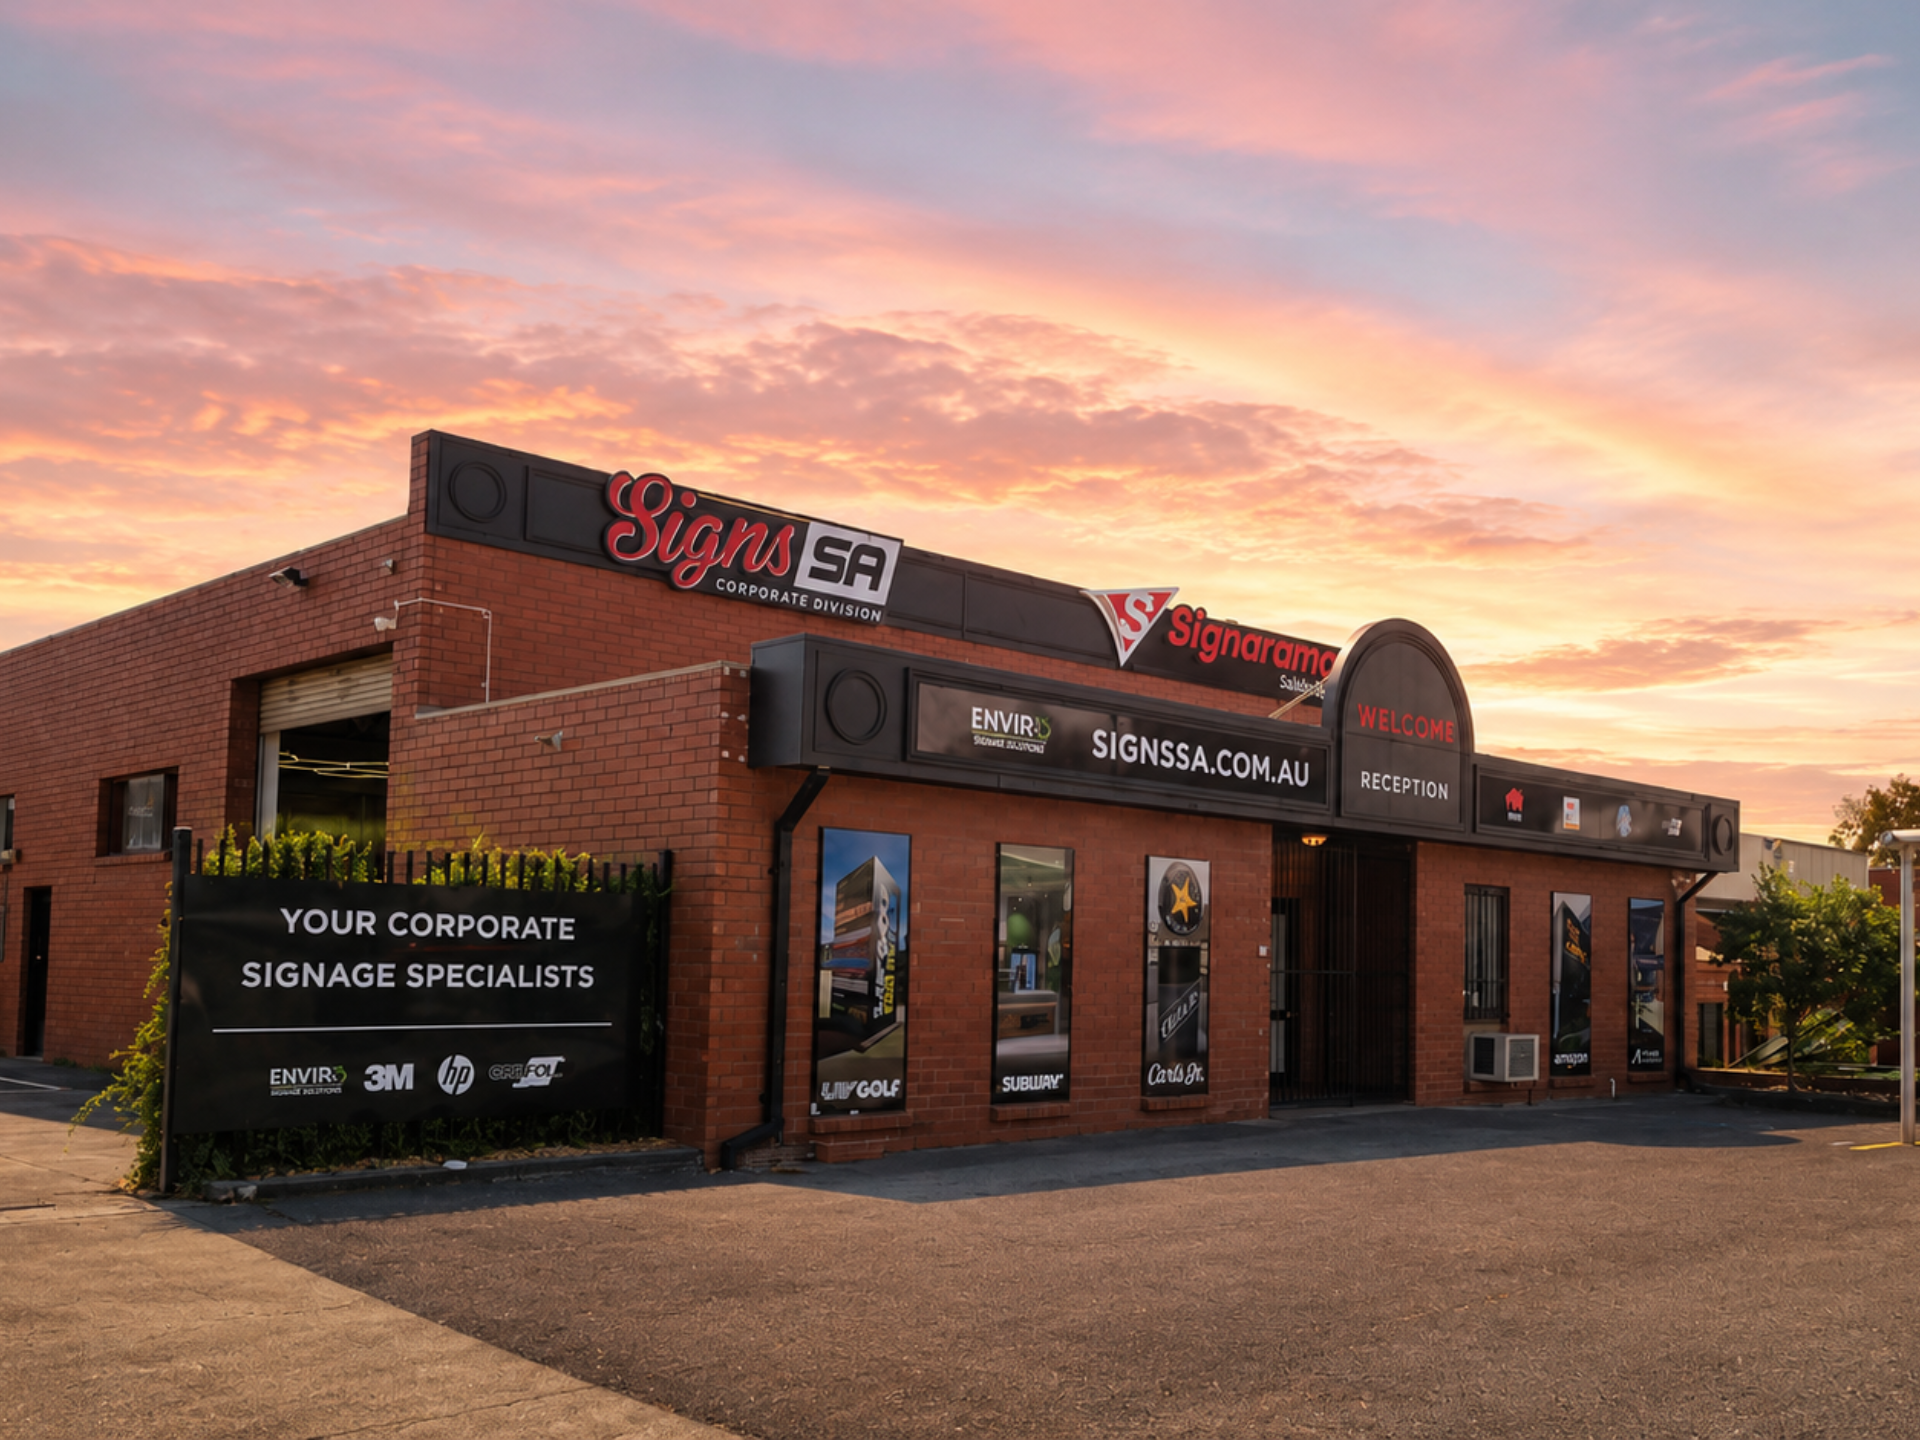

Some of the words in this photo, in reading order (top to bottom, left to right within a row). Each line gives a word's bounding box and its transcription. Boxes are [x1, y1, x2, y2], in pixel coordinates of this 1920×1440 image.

[607, 473, 795, 589] Signs
[808, 535, 887, 592] SA
[715, 578, 809, 607] CORPORATE
[813, 598, 882, 622] DIVISION
[1358, 703, 1454, 743] WELCOME
[1092, 728, 1310, 787] SIGNSSA.COM.AU
[1361, 771, 1448, 800] RECEPTION
[280, 907, 376, 936] YOUR
[388, 911, 575, 941] CORPORATE
[241, 961, 396, 989] SIGNAGE
[406, 963, 595, 989] SPECIALISTS
[363, 1063, 415, 1091] 3M
[440, 1054, 473, 1095] hp
[856, 1079, 901, 1098] GOLF
[1002, 1074, 1064, 1093] SUBWAY
